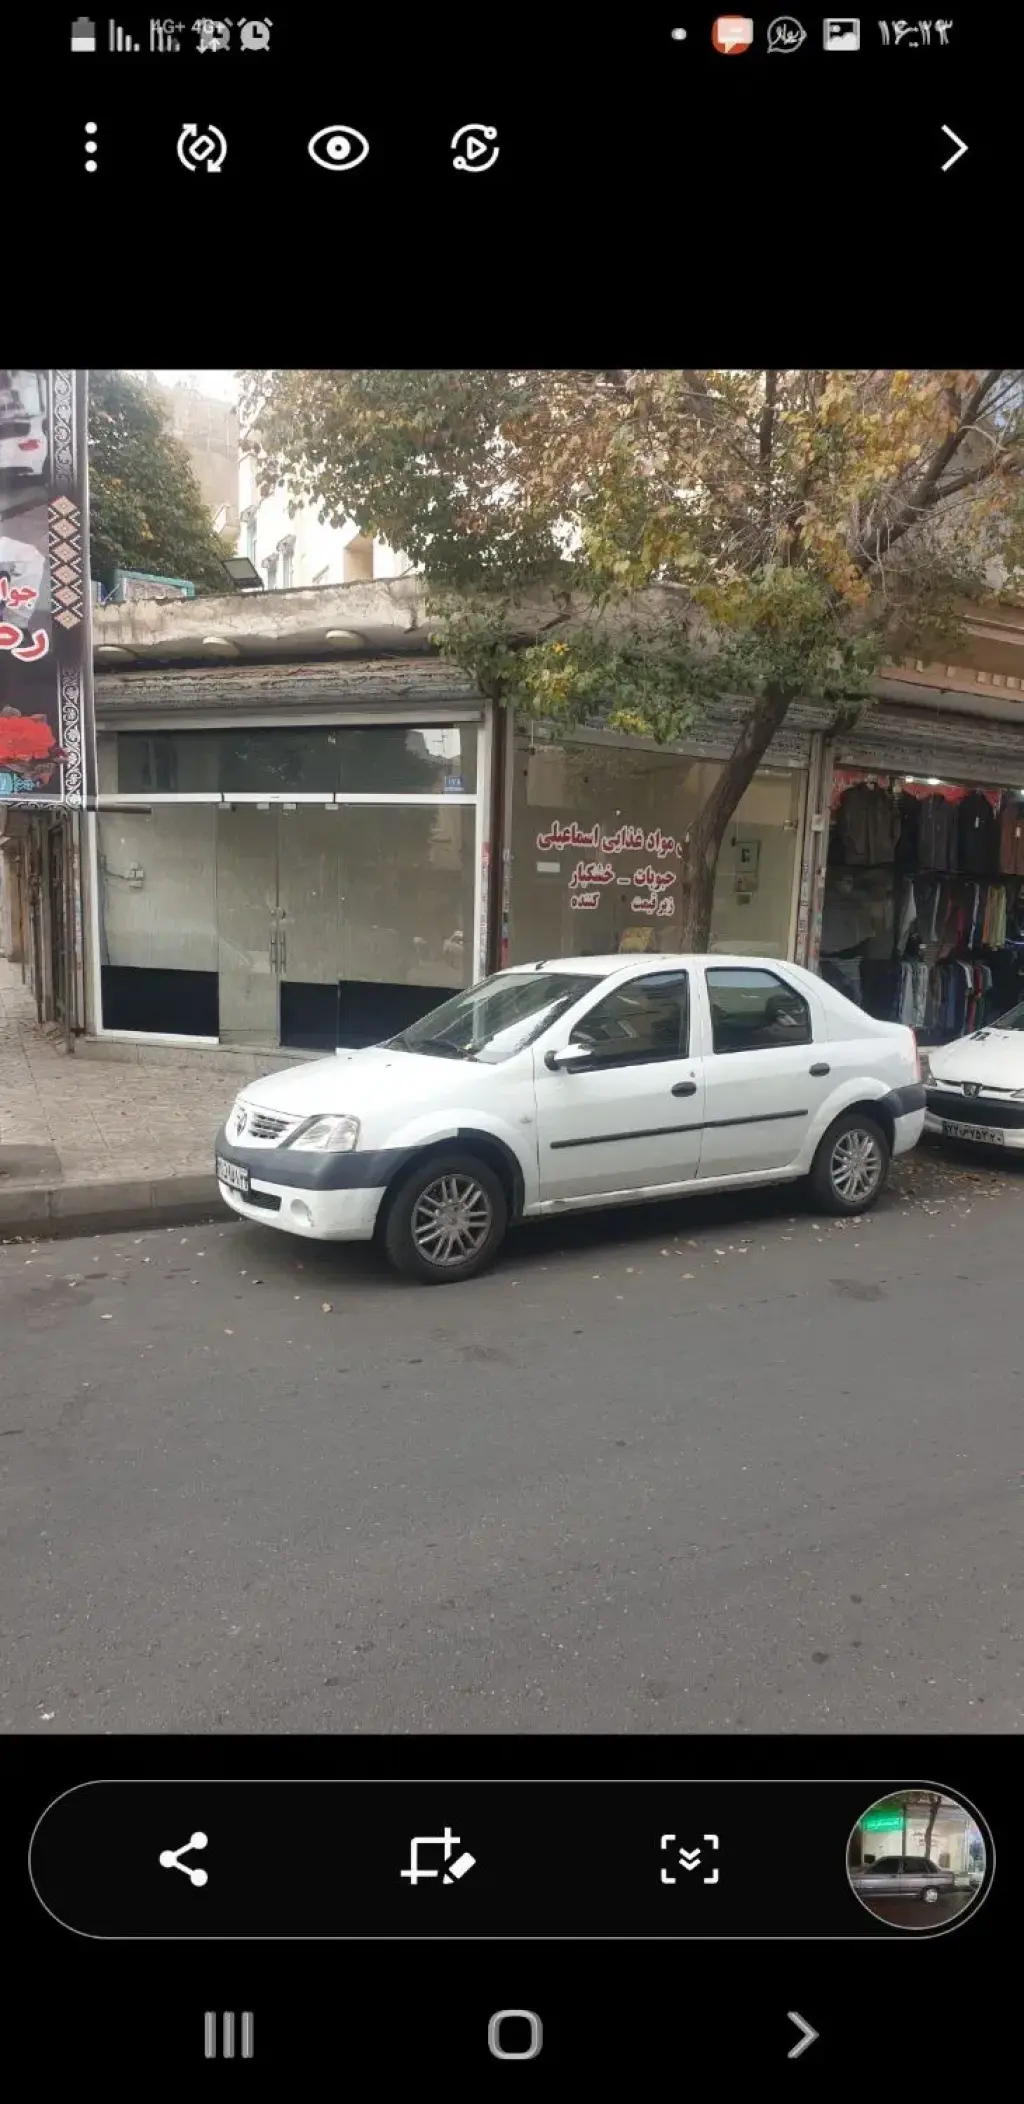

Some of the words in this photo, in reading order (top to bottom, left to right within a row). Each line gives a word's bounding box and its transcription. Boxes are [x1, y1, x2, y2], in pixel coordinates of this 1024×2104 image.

[537, 820, 600, 851] اسماعیلی
[601, 825, 645, 853] غذایی
[645, 828, 676, 858] مواد
[568, 861, 616, 889] خشکبار
[633, 864, 677, 892] حبوبات
